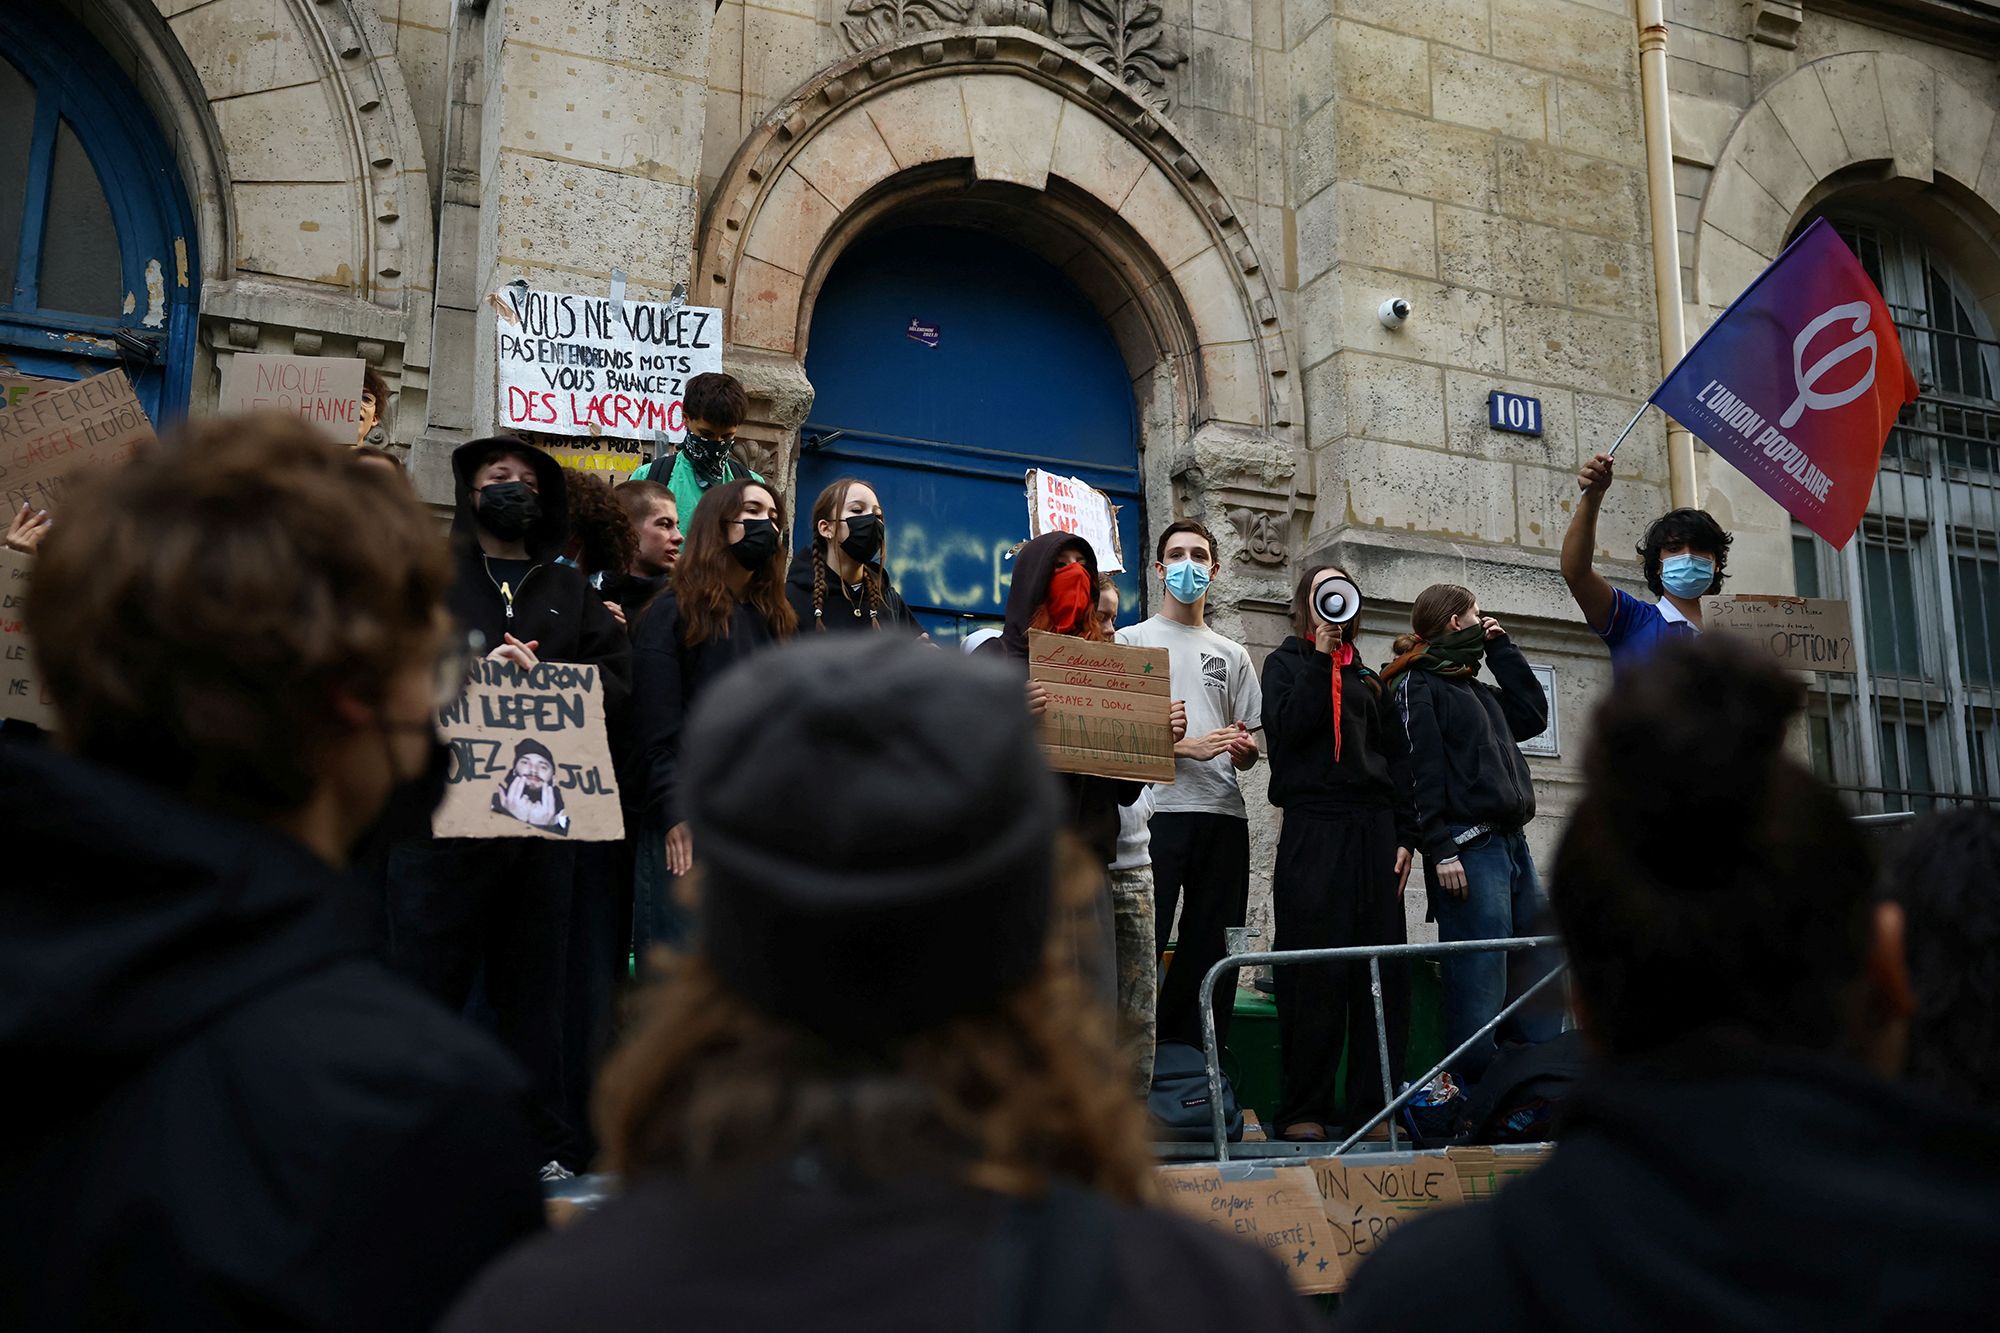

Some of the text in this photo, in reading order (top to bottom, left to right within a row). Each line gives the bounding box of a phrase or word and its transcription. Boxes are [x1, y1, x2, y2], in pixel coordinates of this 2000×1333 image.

[509, 290, 576, 340] VOUS
[584, 299, 613, 339] NE
[501, 334, 535, 363] PAS
[603, 348, 633, 370] NOS
[640, 355, 691, 373] MOTS
[256, 363, 330, 395] NIQUE
[541, 366, 682, 396] VOUS BALANCEZ
[508, 386, 686, 432] DES LACRYMO
[1497, 395, 1535, 430] 101
[608, 438, 641, 454] POUR
[1696, 379, 1835, 504] L'UNION POPULAIRE
[1102, 698, 1134, 712] DONC
[558, 763, 615, 795] JUL
[1317, 1168, 1349, 1200] UN
[1234, 1218, 1257, 1233] EN
